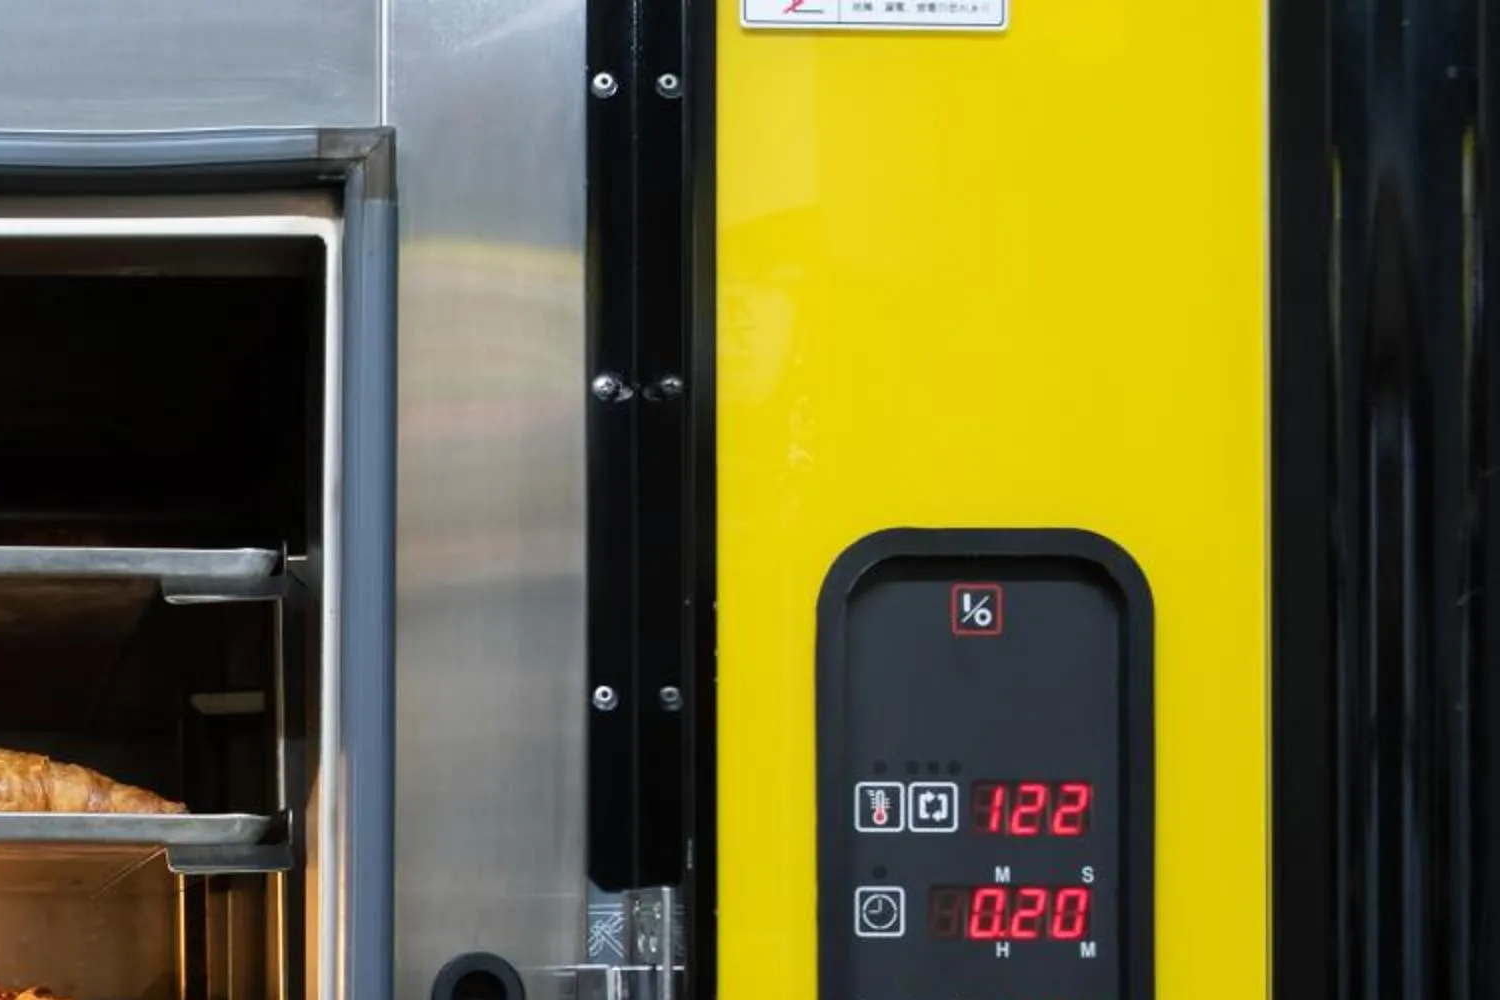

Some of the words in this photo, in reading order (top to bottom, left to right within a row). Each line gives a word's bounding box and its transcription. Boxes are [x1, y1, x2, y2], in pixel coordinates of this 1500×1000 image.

[988, 783, 1092, 835] 122
[995, 866, 1011, 883] M
[1080, 866, 1095, 883] S
[995, 941, 1010, 957] H
[1080, 941, 1096, 957] M
